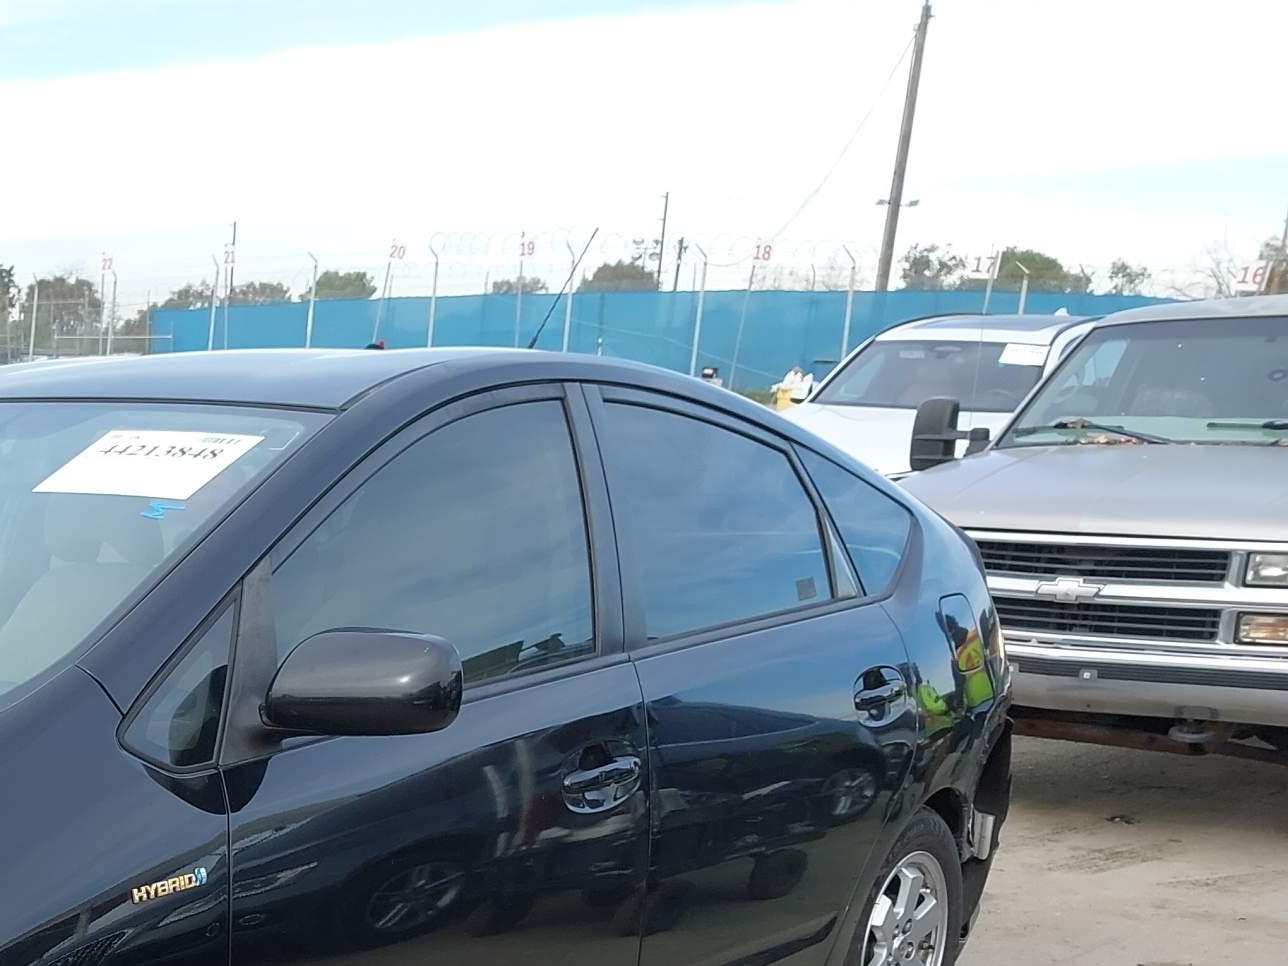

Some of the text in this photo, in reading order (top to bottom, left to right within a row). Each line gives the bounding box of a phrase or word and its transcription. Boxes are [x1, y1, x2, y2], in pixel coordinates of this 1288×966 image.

[223, 250, 235, 264] 21
[389, 245, 406, 259] 20
[520, 241, 535, 256] 19
[753, 244, 772, 261] 18
[102, 256, 113, 271] 22
[971, 256, 998, 273] 17
[1237, 265, 1265, 285] 16
[99, 443, 225, 460] 44213848
[132, 873, 197, 904] HYBRID
